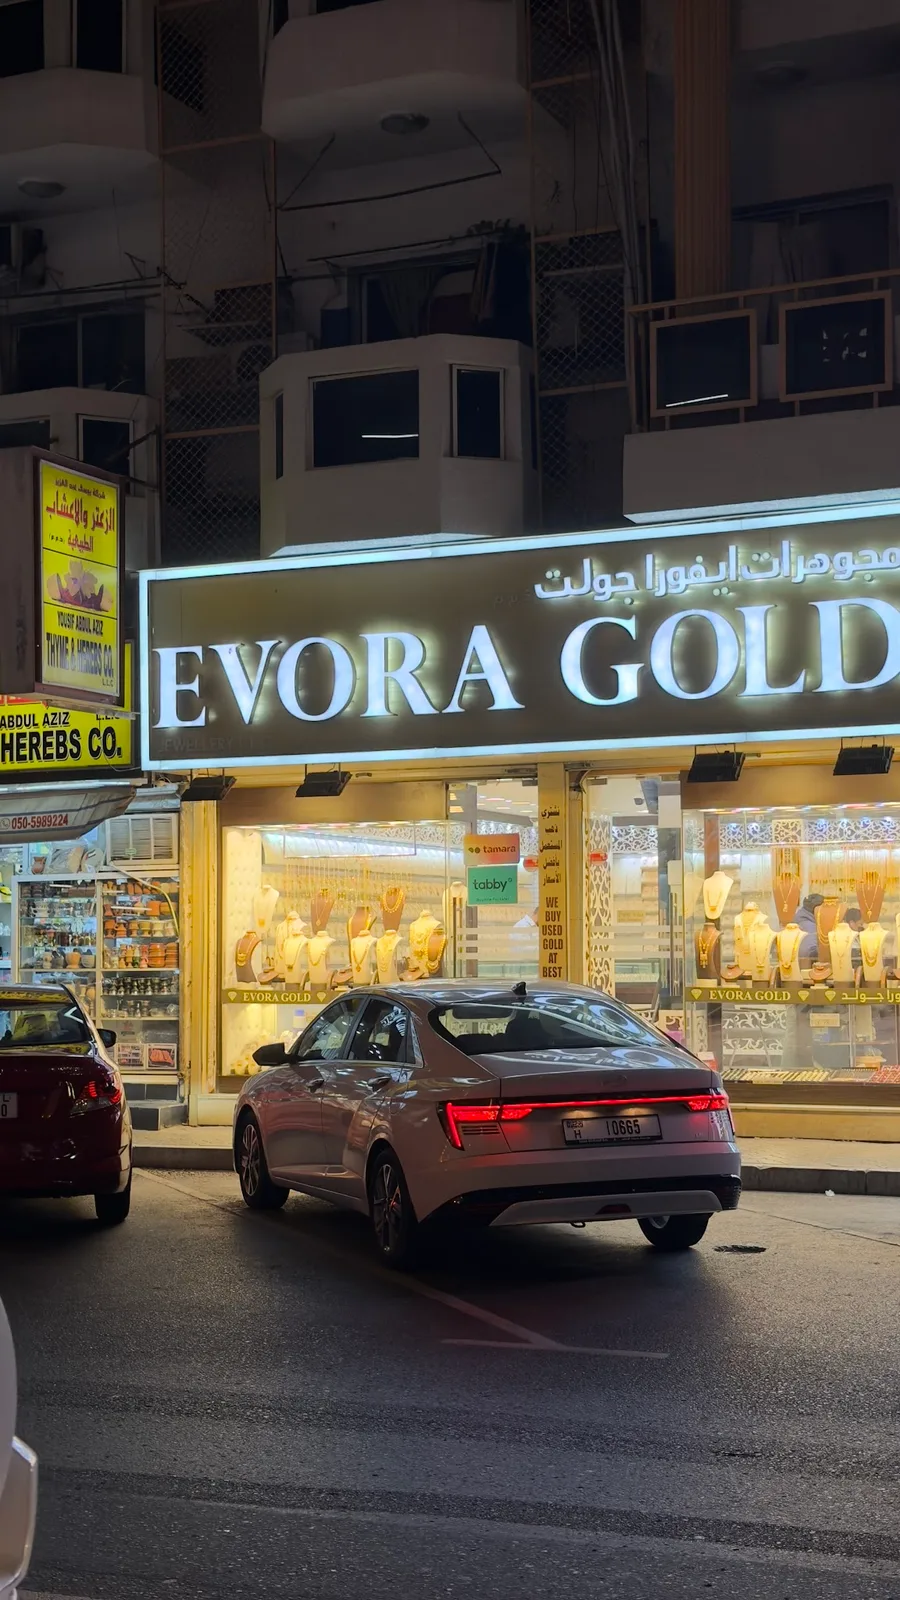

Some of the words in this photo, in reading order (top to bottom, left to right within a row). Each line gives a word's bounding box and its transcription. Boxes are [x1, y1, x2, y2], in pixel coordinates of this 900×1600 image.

[91, 506, 115, 535] الزعتر
[68, 529, 94, 553] الطبيعية
[741, 540, 900, 584] مجوهرات
[57, 611, 75, 630] YOUSIF
[75, 615, 92, 635] ABDUL
[93, 619, 104, 636] AZIZ
[46, 632, 69, 671] THYME
[71, 637, 76, 671] &
[77, 639, 102, 676] HEREBS
[152, 624, 526, 730] EVORA
[559, 597, 900, 707] GOLD
[0, 713, 39, 729] ABDUL
[42, 712, 70, 727] AZIZ
[1, 728, 81, 763] HEREBS
[88, 726, 122, 759] CO.
[11, 814, 69, 830] 050-5989224
[483, 845, 516, 854] tamara
[473, 878, 508, 892] tabby
[545, 897, 559, 908] WE
[545, 911, 561, 922] BUY
[542, 924, 563, 936] USED
[542, 938, 564, 950] GOLD
[548, 952, 558, 964] AT
[542, 966, 563, 978] BEST
[243, 992, 279, 1002] EVORA
[281, 992, 311, 1002] GOLD
[709, 990, 752, 1001] EVORA
[755, 990, 791, 1001] GOLD
[574, 1129, 582, 1139] H
[606, 1119, 641, 1136] 10665
